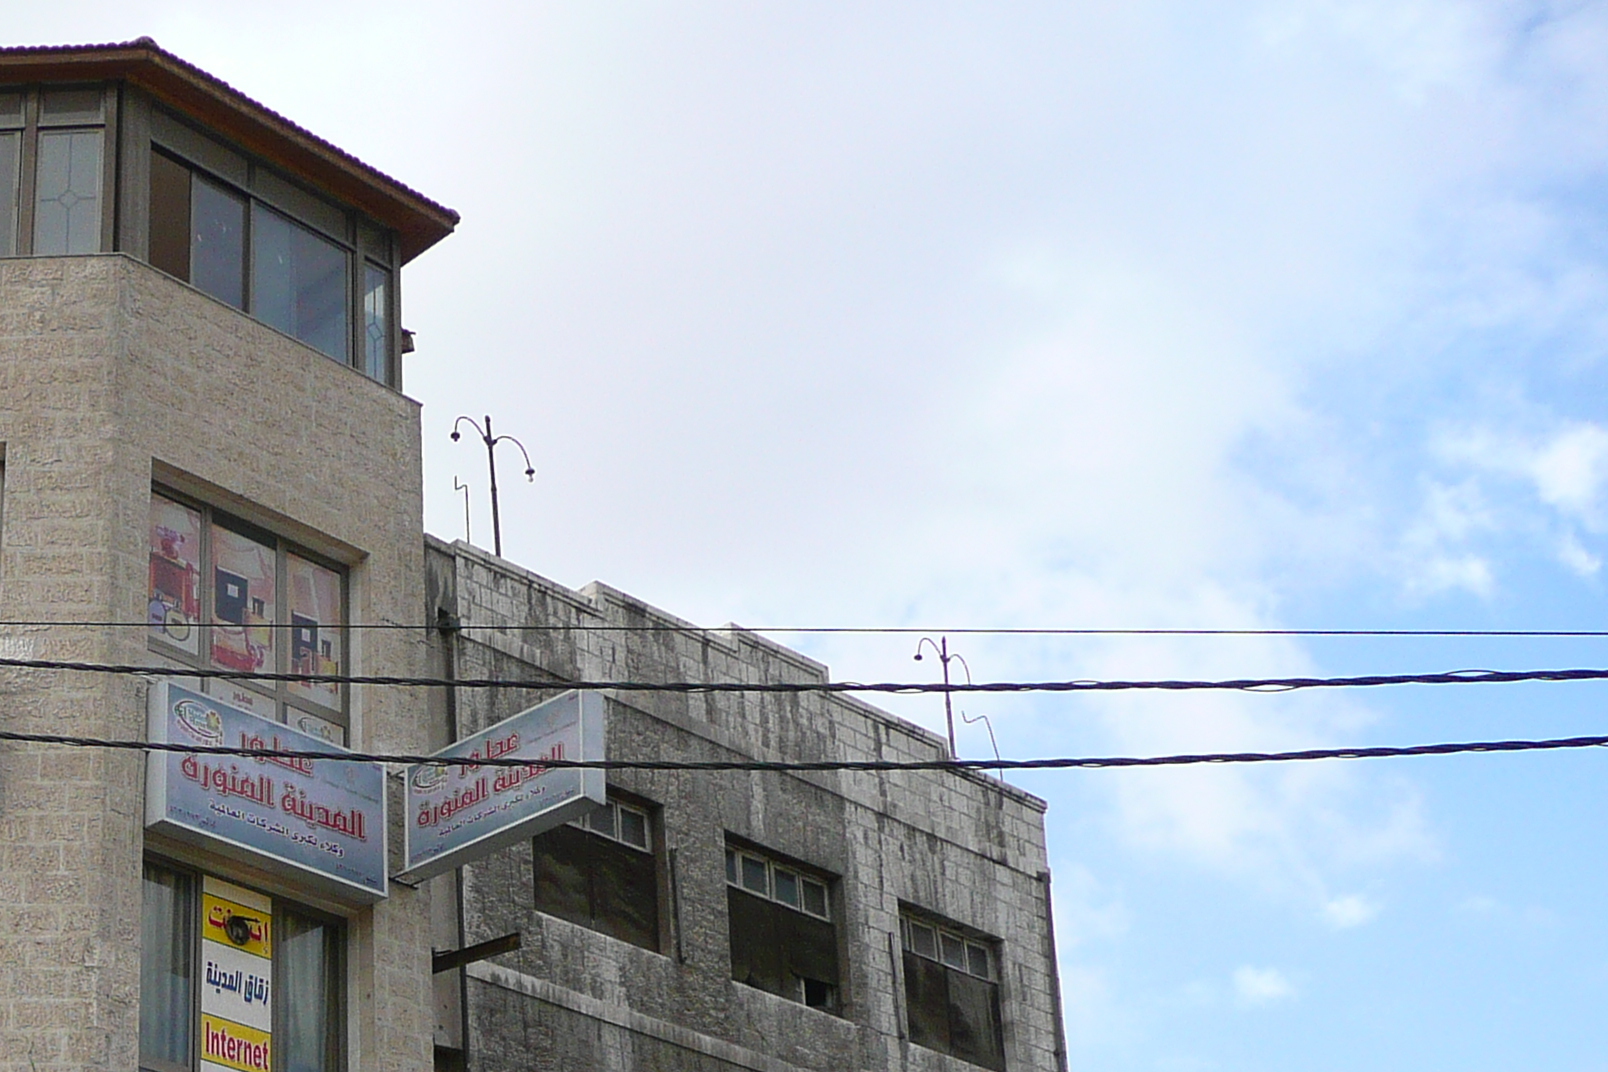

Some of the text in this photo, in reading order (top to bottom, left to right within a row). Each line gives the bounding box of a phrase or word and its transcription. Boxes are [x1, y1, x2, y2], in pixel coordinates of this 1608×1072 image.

[240, 731, 314, 777] عطور
[182, 750, 367, 842] المدينة المنورة
[417, 777, 487, 828] المنورة
[206, 961, 269, 1006] زقاق المدينة
[206, 1021, 268, 1071] Internet
